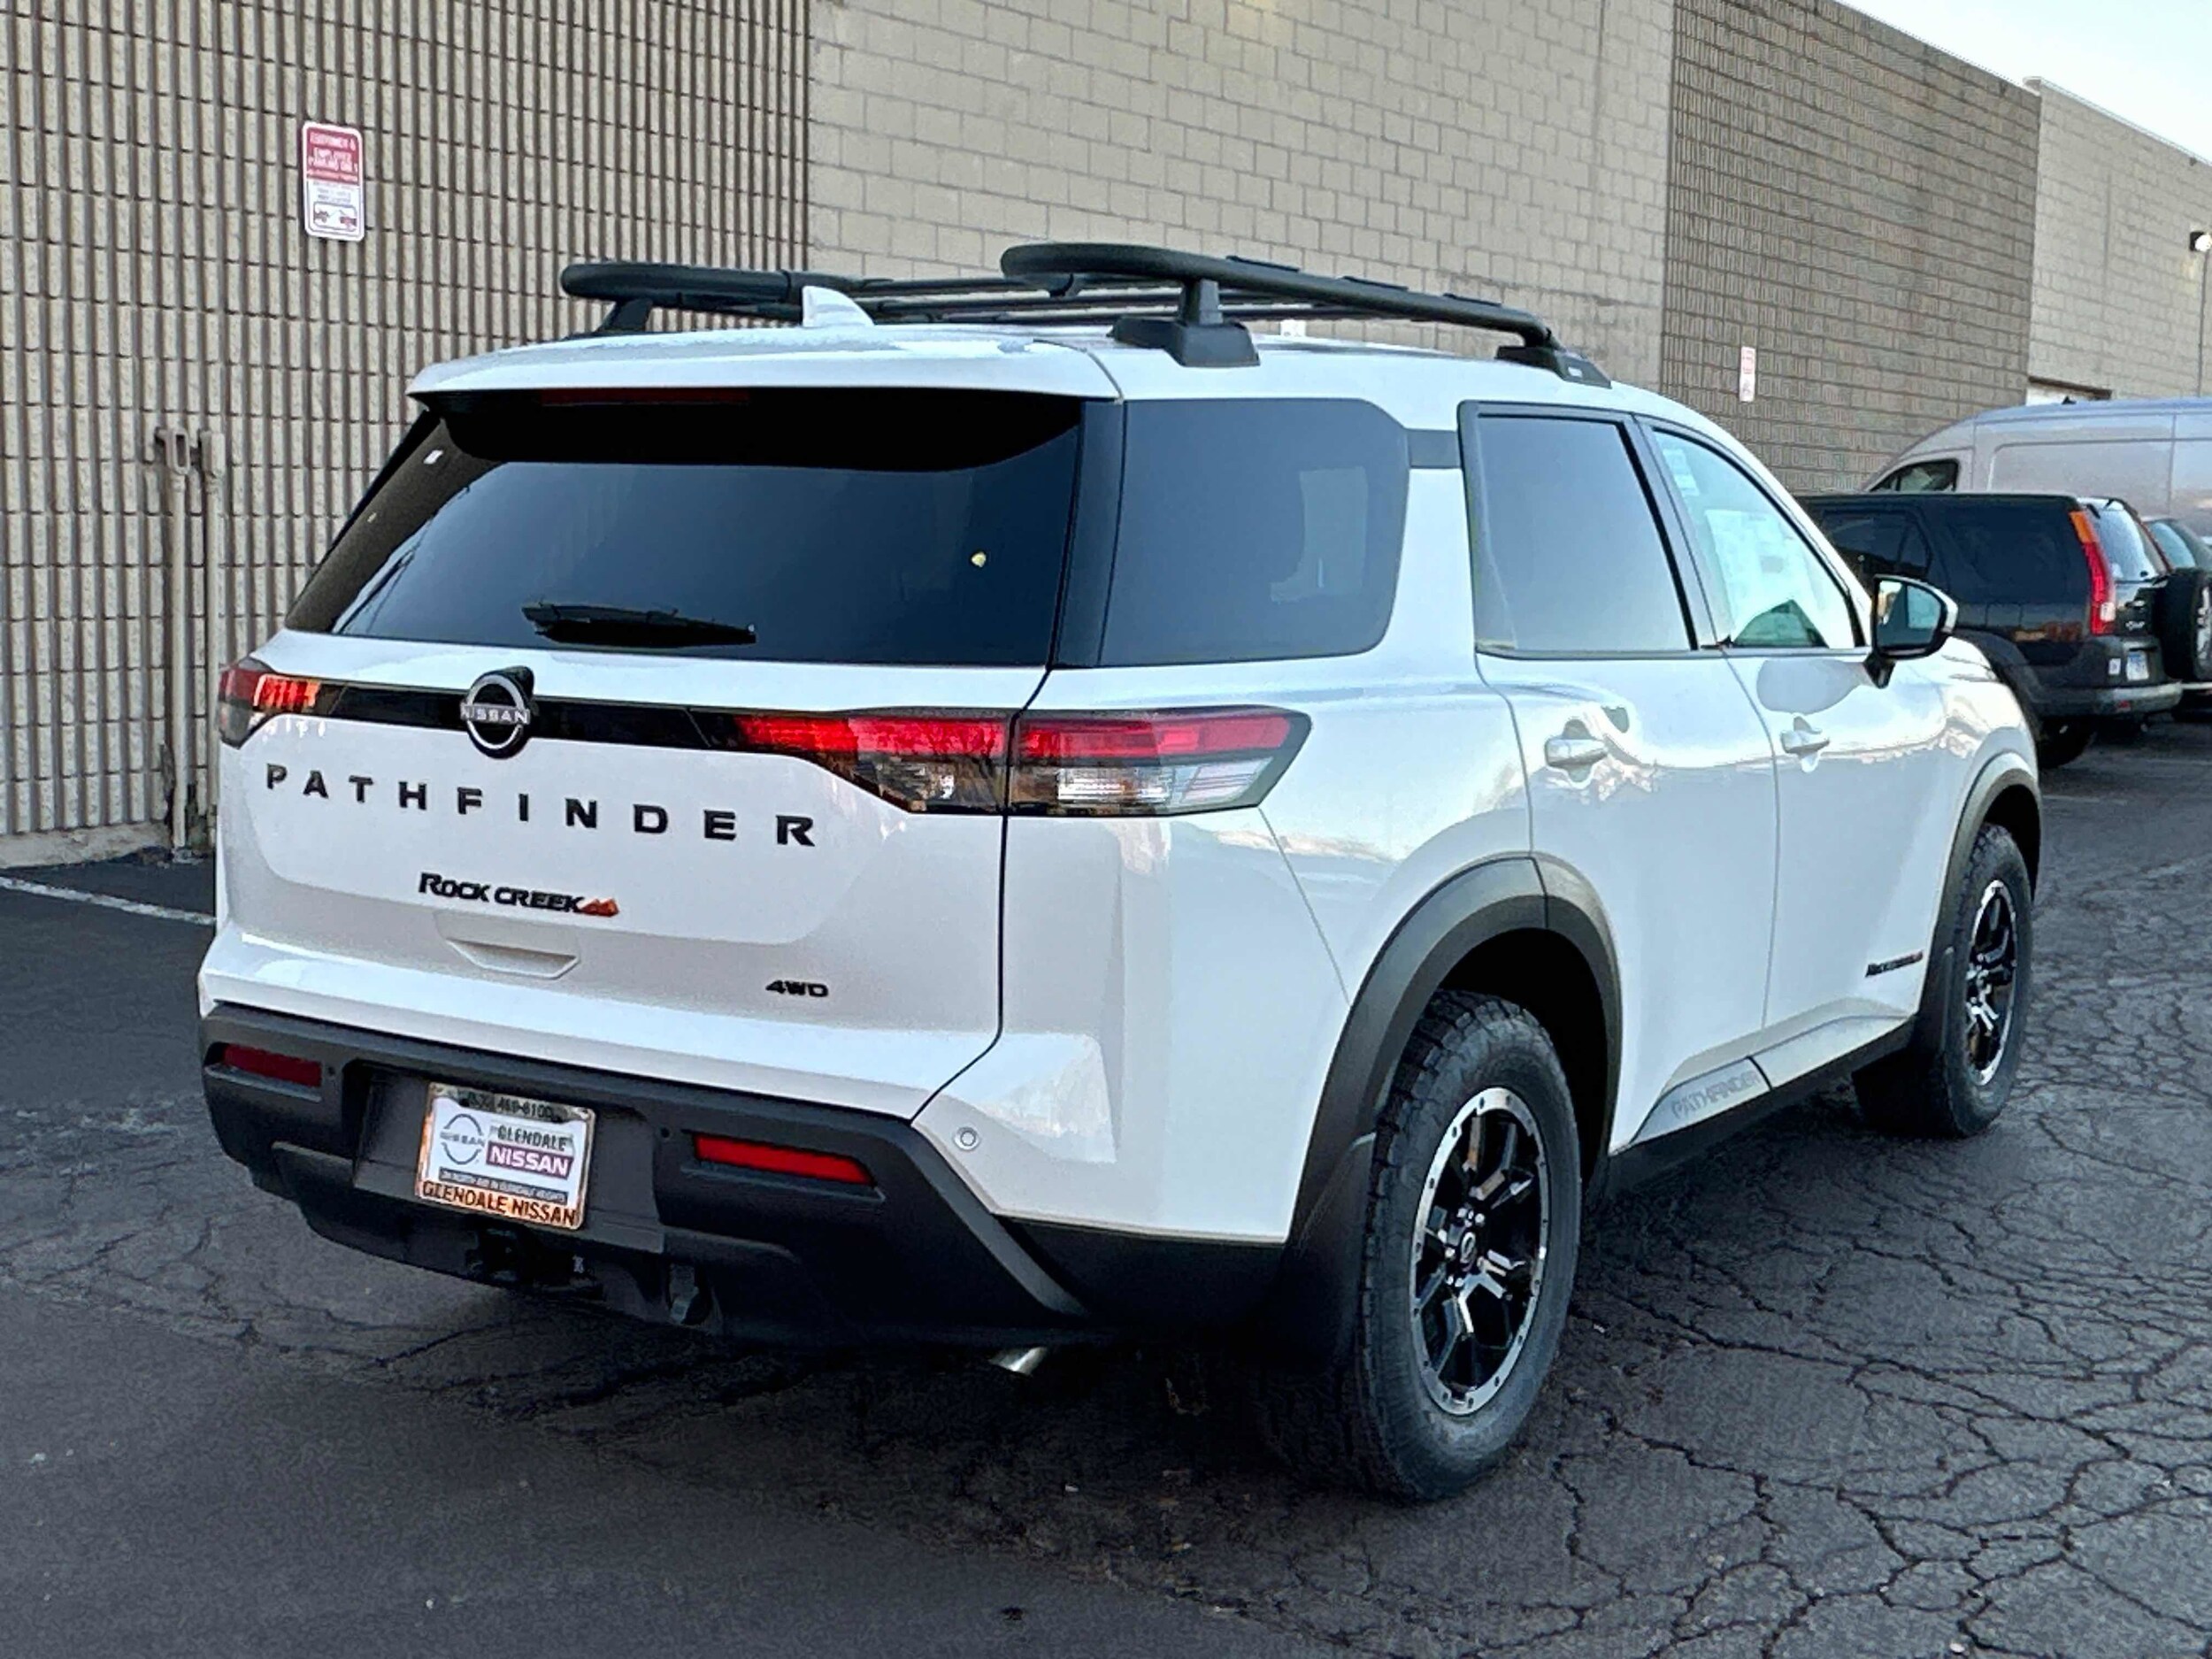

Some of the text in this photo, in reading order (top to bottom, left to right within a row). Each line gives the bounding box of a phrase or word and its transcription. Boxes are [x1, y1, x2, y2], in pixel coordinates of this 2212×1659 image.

[460, 703, 530, 725] NISSAN
[265, 763, 815, 848] PATHFINDER
[419, 872, 585, 913] ROCK CREEK
[765, 979, 829, 997] 4WD
[440, 1132, 485, 1148] NISSAN
[497, 1125, 567, 1151] GLENDALE
[489, 1145, 569, 1178] NISSAN
[422, 1180, 577, 1226] GLENDALE NISSAN
